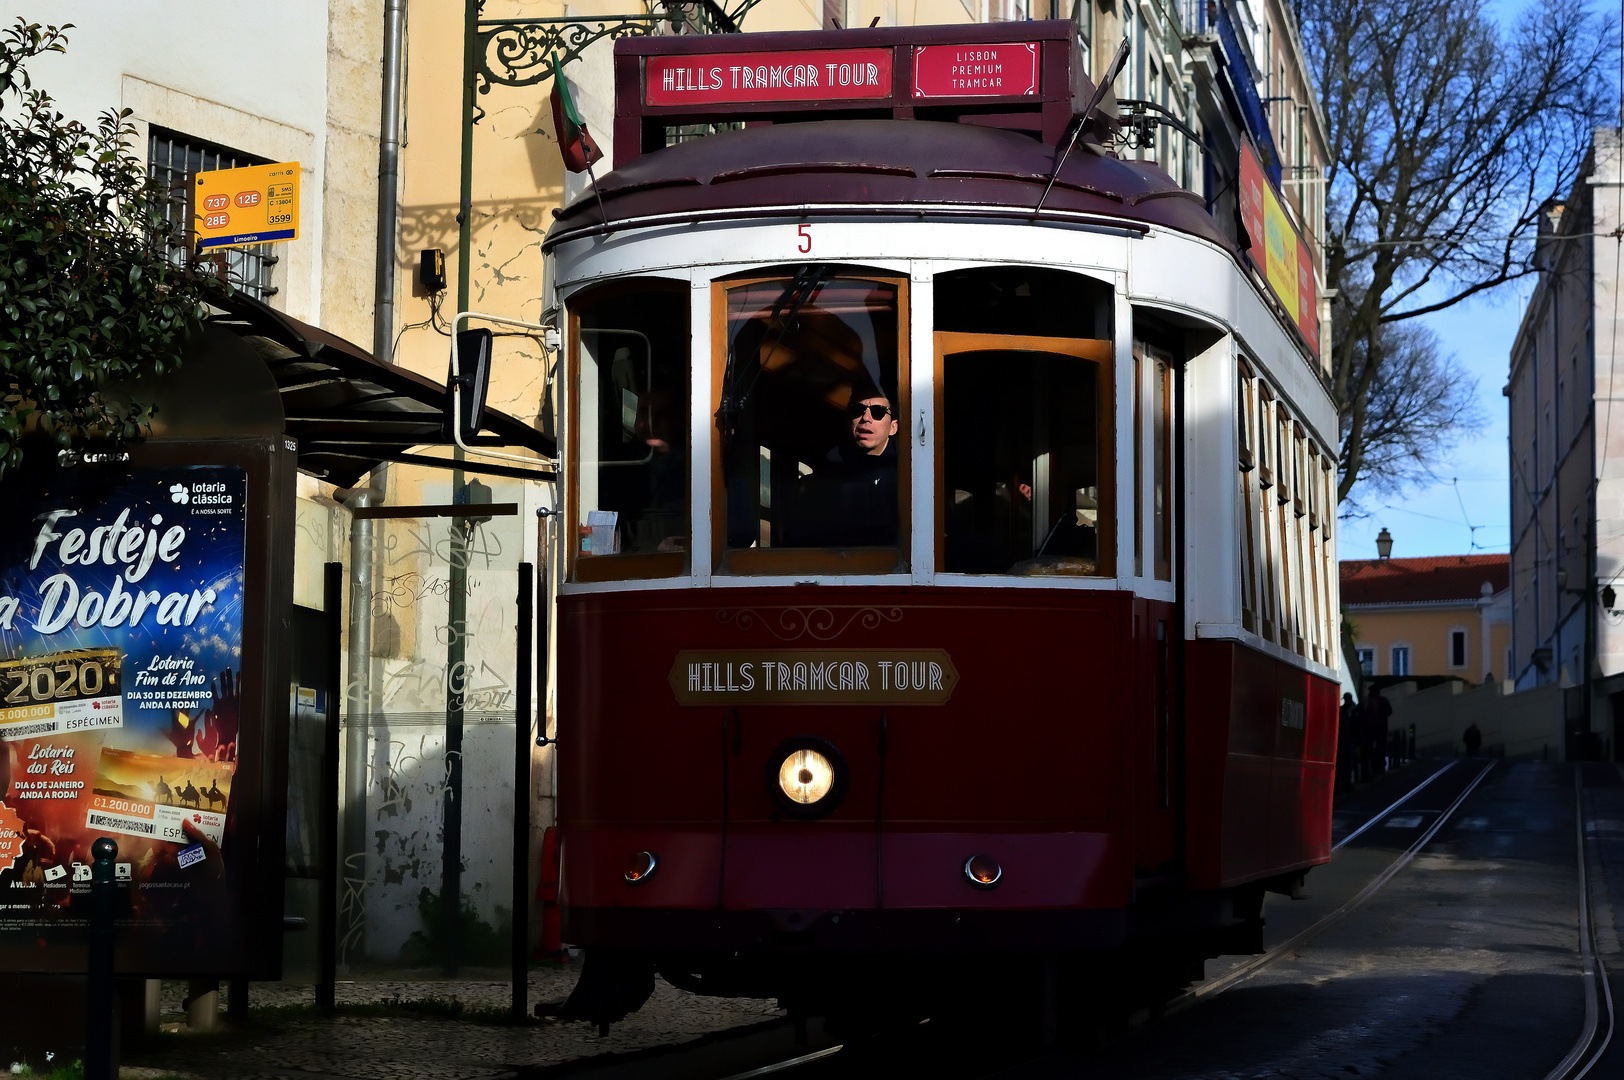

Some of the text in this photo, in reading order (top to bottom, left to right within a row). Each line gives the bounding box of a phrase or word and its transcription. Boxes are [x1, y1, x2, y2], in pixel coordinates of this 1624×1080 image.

[956, 50, 998, 62] LISBON
[952, 64, 1003, 76] PREMIUM
[663, 62, 880, 92] HILLS TRAMCAR TOUR
[952, 78, 1003, 89] TRAMCAR
[207, 194, 258, 208] 737 12E
[206, 215, 226, 226] 28E
[270, 214, 291, 224] 3599
[798, 224, 812, 254] 5
[284, 440, 296, 452] 1325
[192, 482, 226, 492] lotaria
[192, 494, 232, 504] clássica
[30, 507, 186, 583] Festeje
[32, 574, 217, 634] Dobrar
[147, 655, 195, 672] Lotaria
[5, 661, 103, 704] 2020
[135, 672, 160, 688] Fim
[180, 672, 206, 686] Ano
[688, 660, 944, 692] HILLS TRAMCAR TOUR
[127, 690, 212, 700] DIA 30 DE DEZEMBRO
[139, 700, 199, 710] ANDA A RODA!
[66, 716, 120, 730] ESPÉCIMEN
[28, 744, 75, 760] Lotaria
[27, 759, 75, 776] dos Reis
[14, 780, 84, 790] DIA 6 DE JANEIRO
[20, 790, 78, 800] ANDA A RODA!
